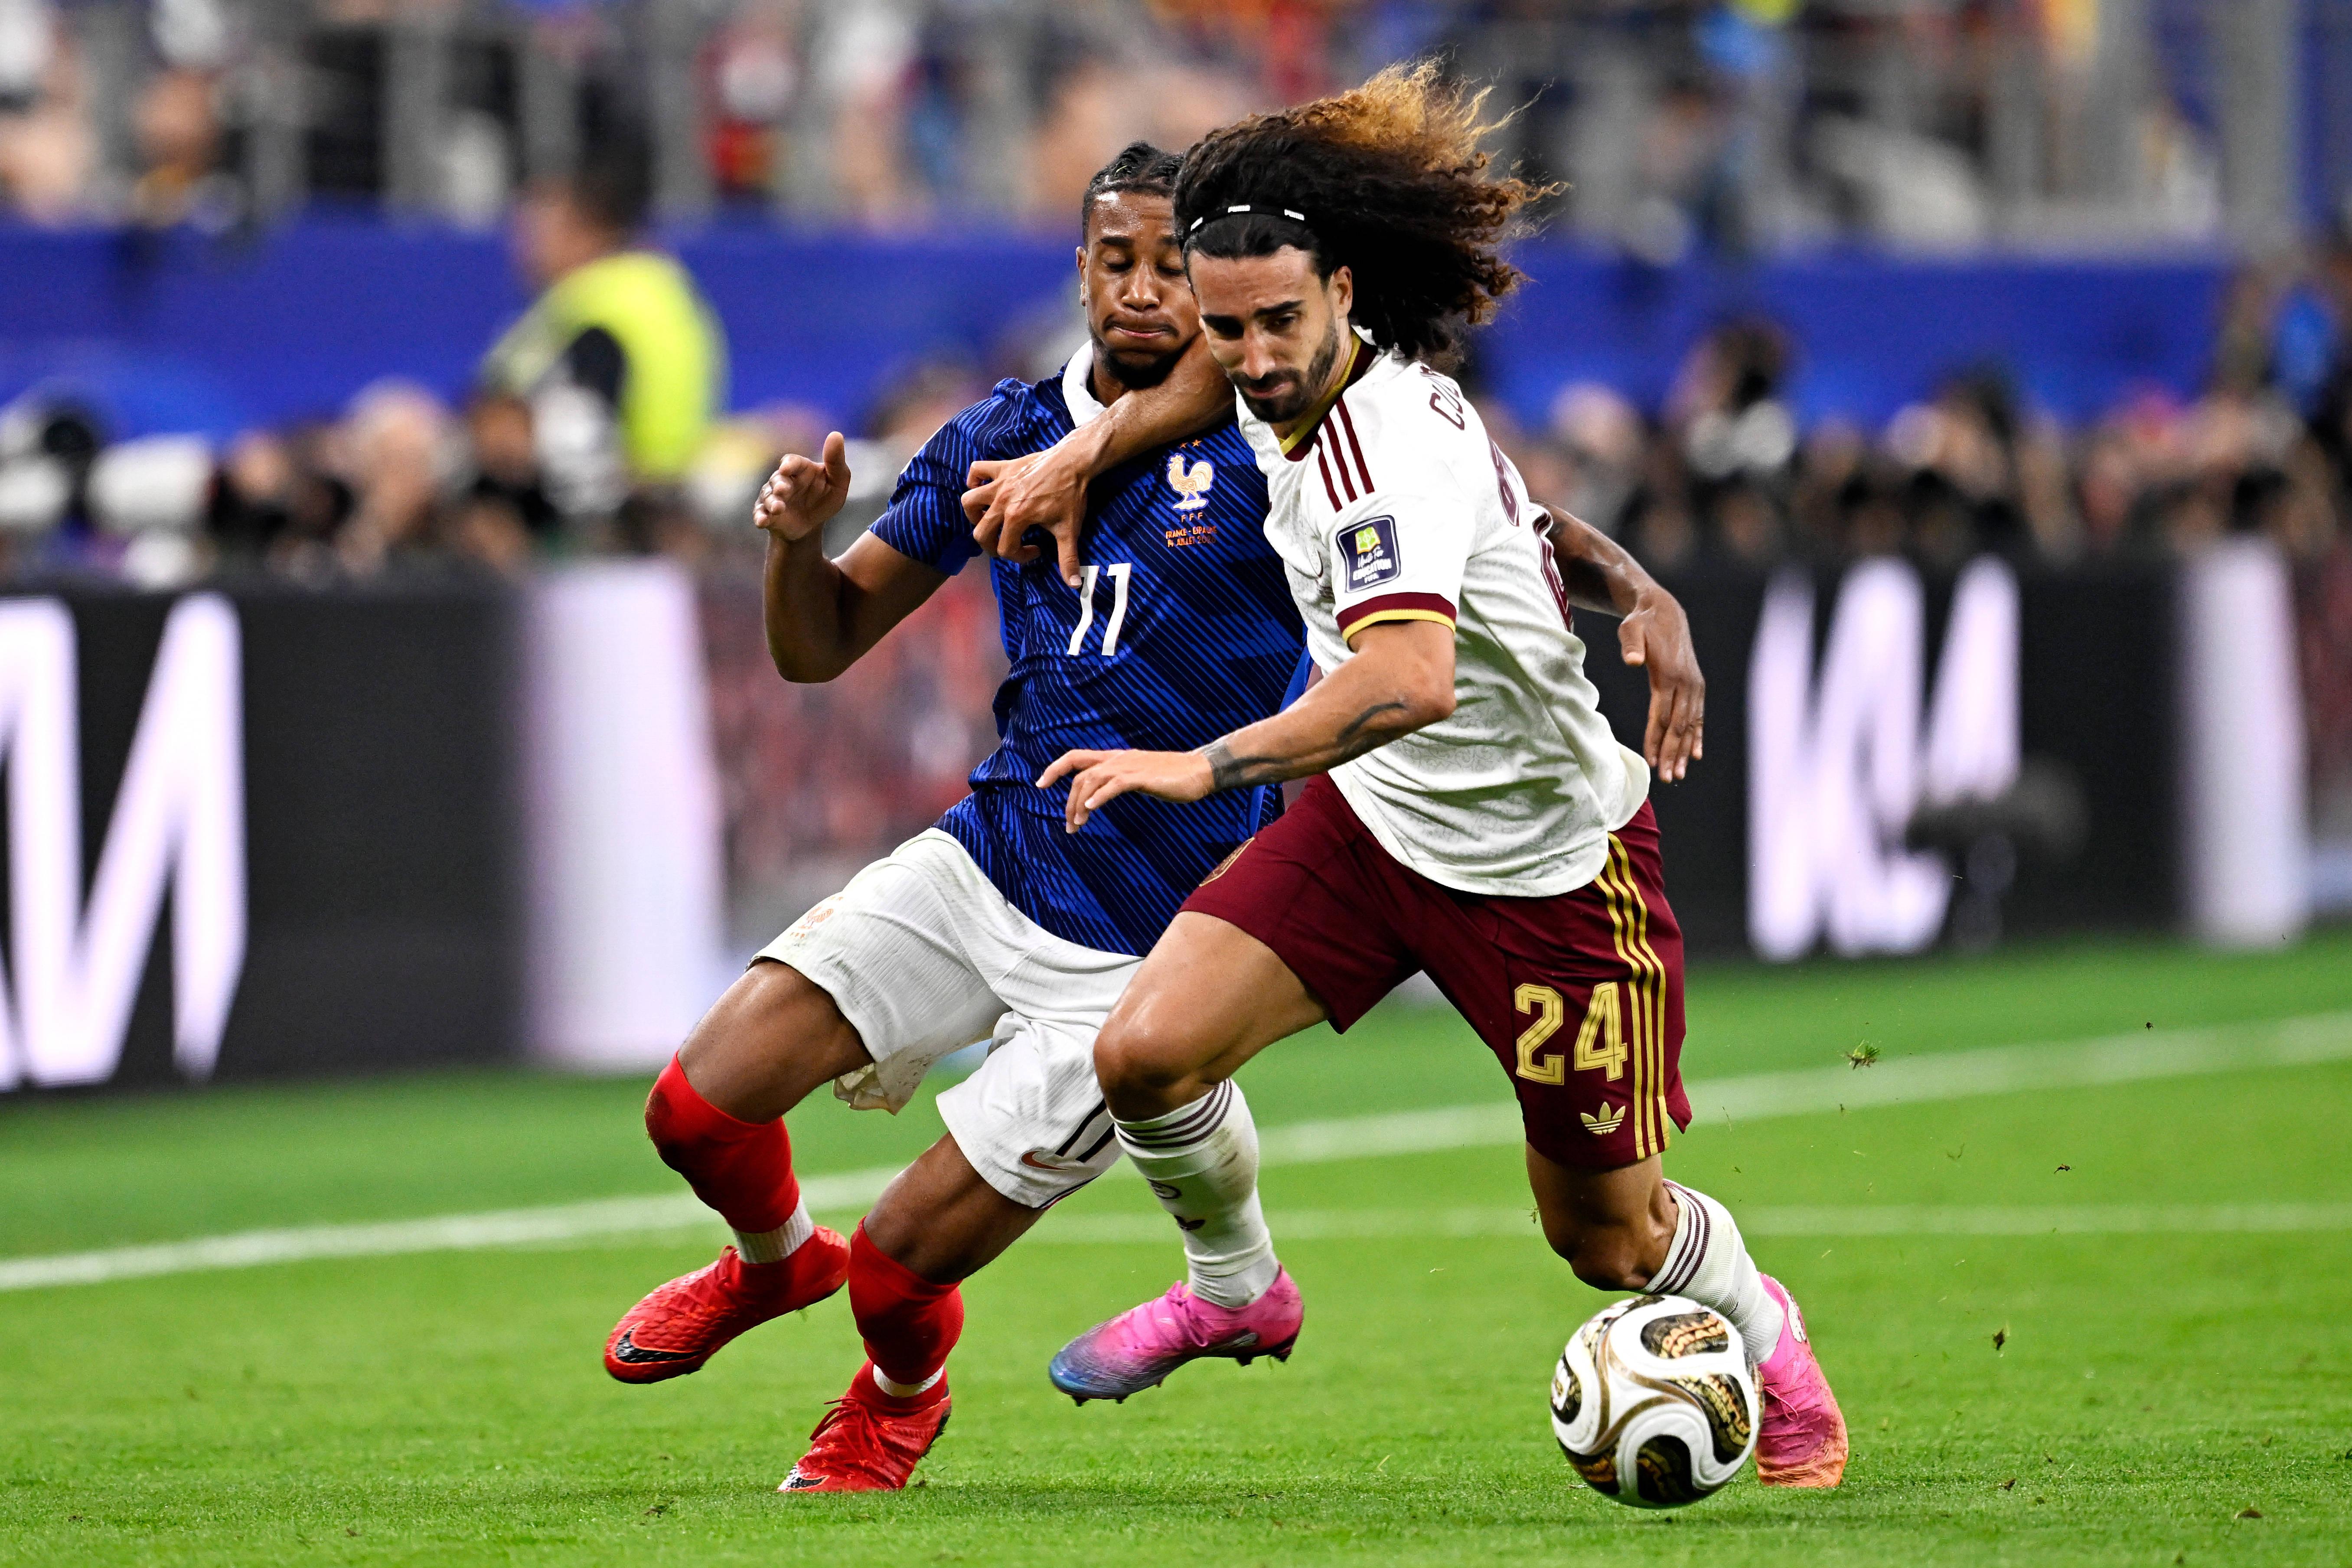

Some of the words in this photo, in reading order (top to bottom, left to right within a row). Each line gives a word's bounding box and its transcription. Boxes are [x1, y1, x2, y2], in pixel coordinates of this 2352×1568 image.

[1166, 528, 1187, 539] FRANCE
[1176, 536, 1195, 546] JUILLET
[1353, 558, 1392, 581] EDUCATION
[1364, 573, 1380, 584] FIFA
[1515, 981, 1628, 1086] 24
